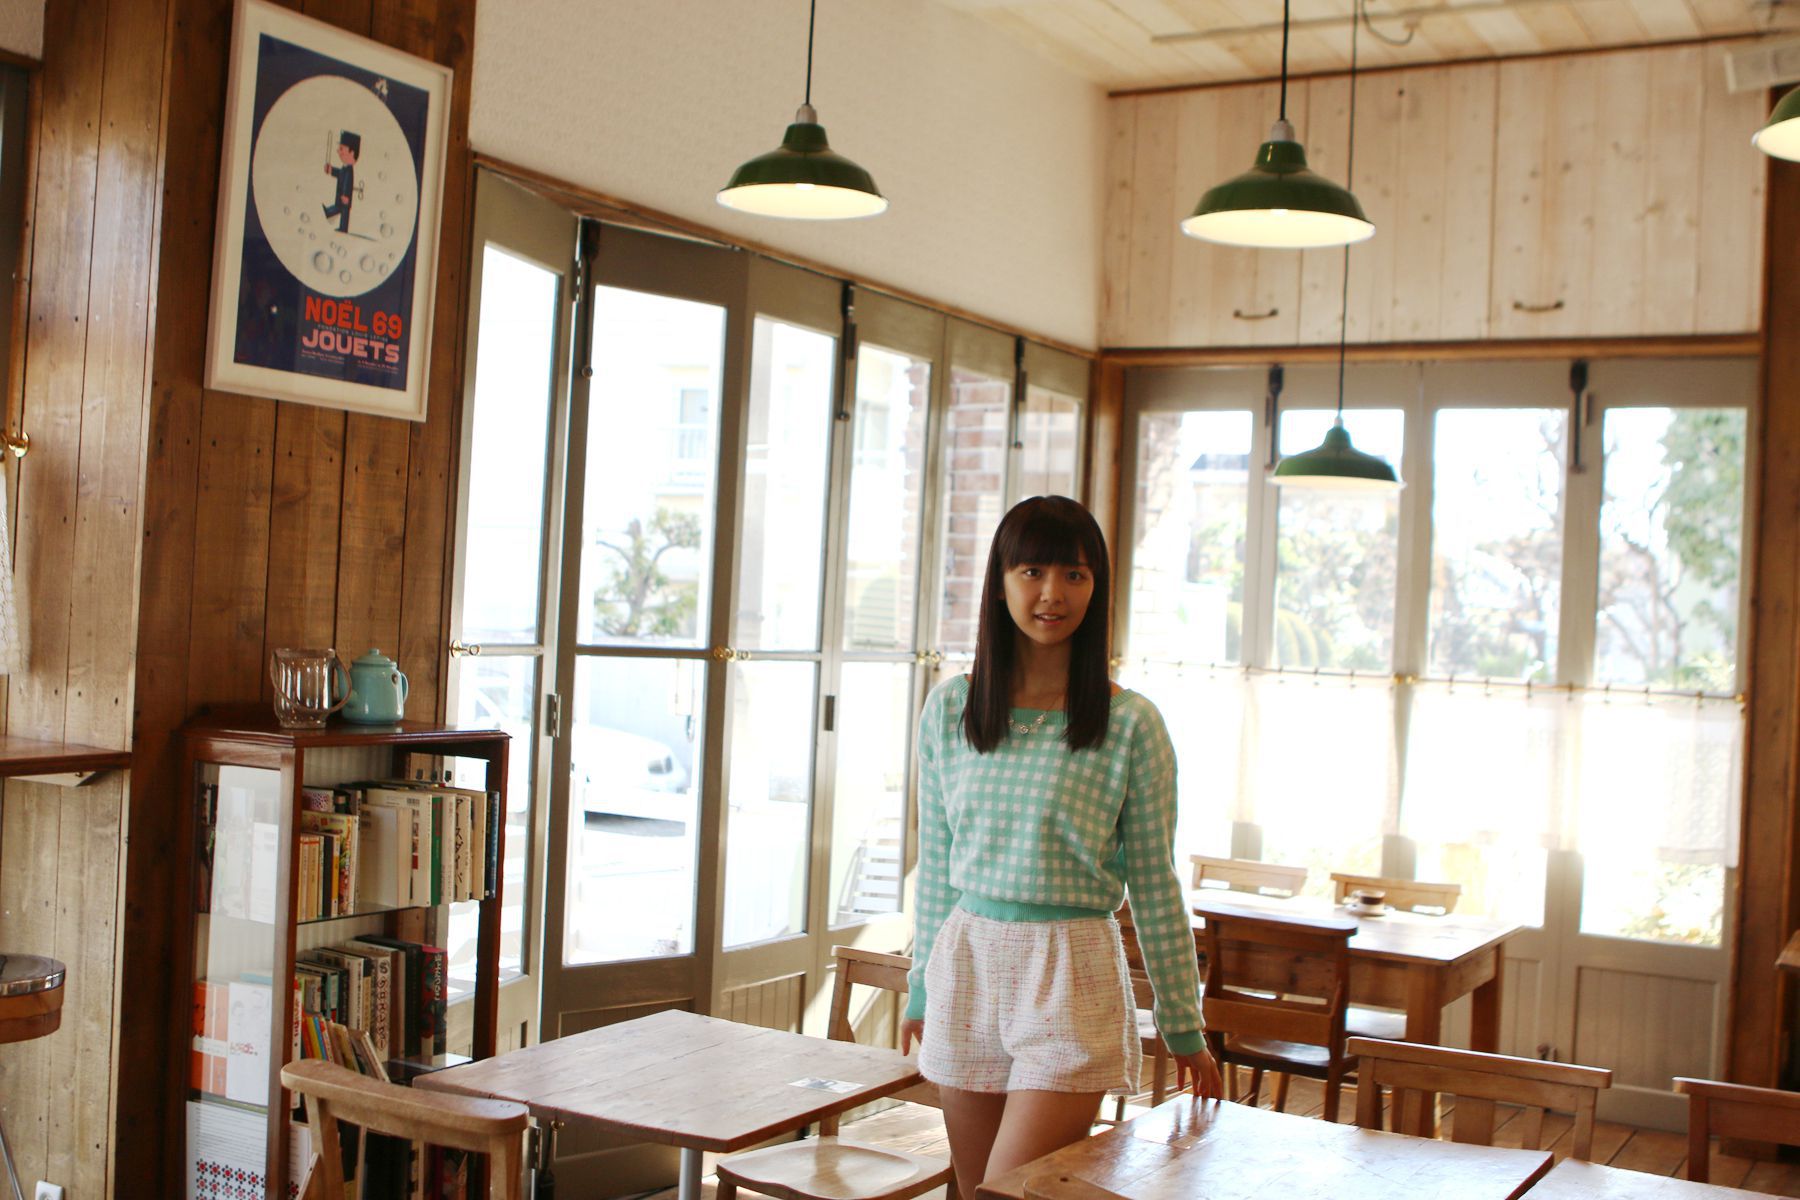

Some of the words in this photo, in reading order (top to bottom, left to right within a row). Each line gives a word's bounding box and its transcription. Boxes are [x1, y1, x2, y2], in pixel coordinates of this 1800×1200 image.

[305, 296, 368, 333] NOËL
[372, 310, 403, 340] 69
[302, 328, 400, 364] JOUETS
